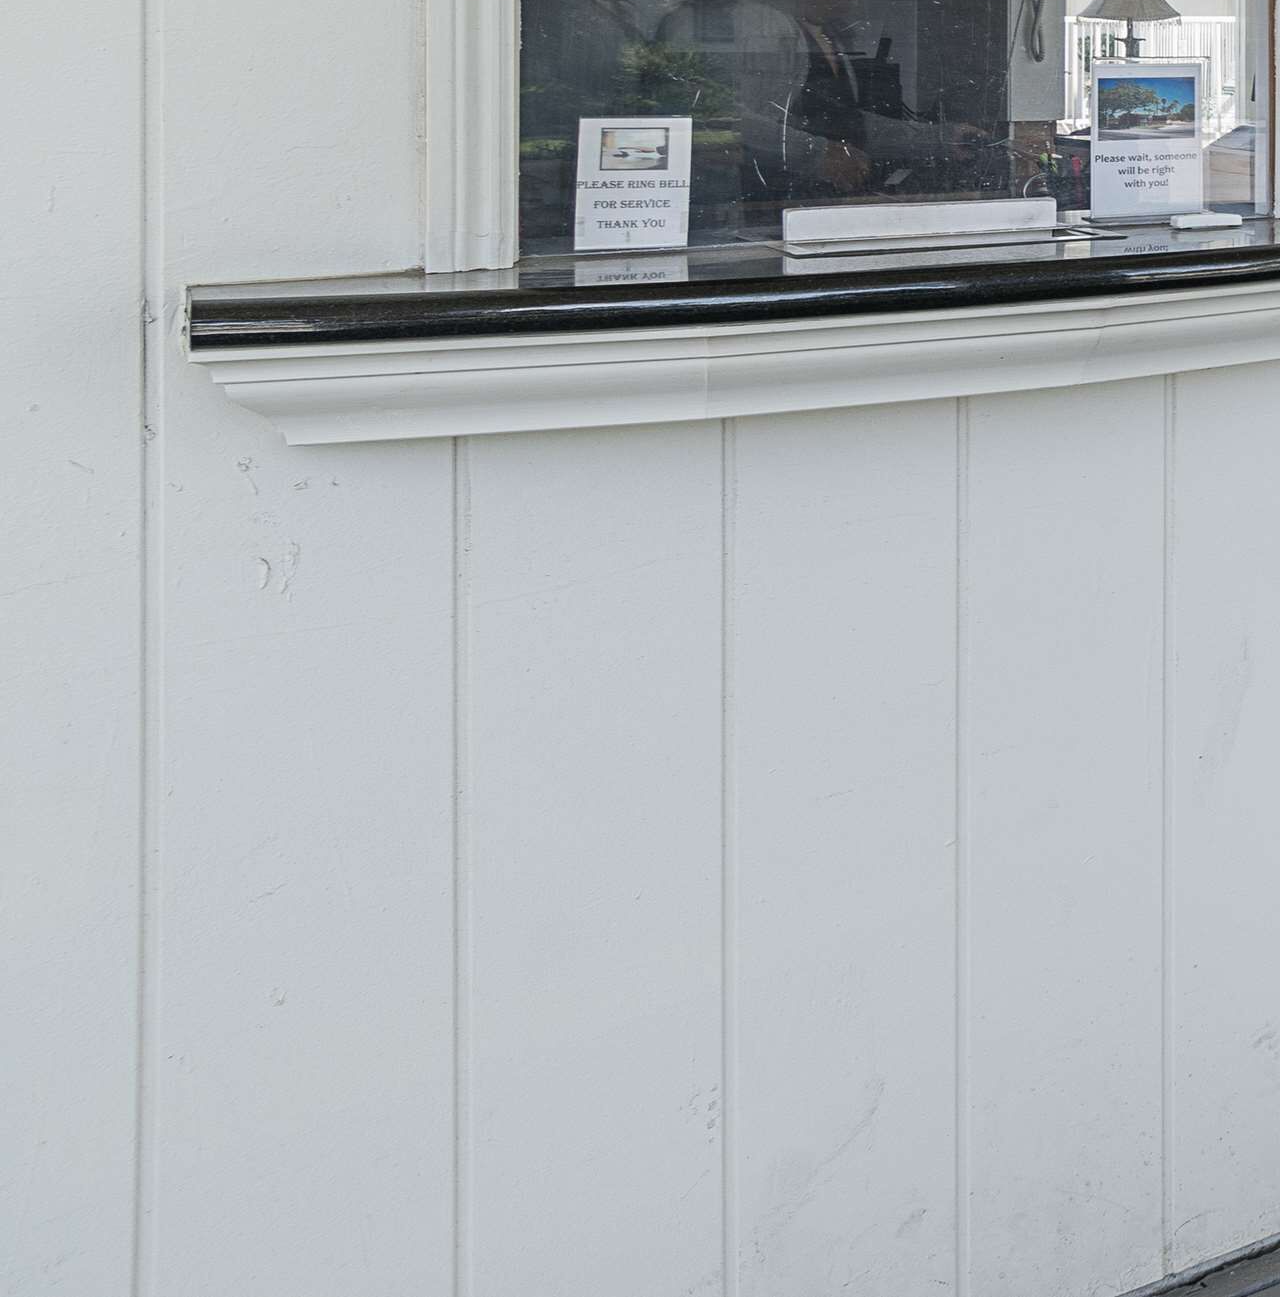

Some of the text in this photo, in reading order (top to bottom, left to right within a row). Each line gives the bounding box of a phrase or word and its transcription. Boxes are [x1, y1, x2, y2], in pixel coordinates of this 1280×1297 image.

[1094, 153, 1197, 163] Please wait, someone
[1118, 165, 1175, 176] will be right
[576, 179, 689, 189] PLEASE RING BELL
[1124, 179, 1168, 189] with you!
[593, 199, 671, 209] FOR SERVICE
[596, 218, 666, 229] THANK YOU
